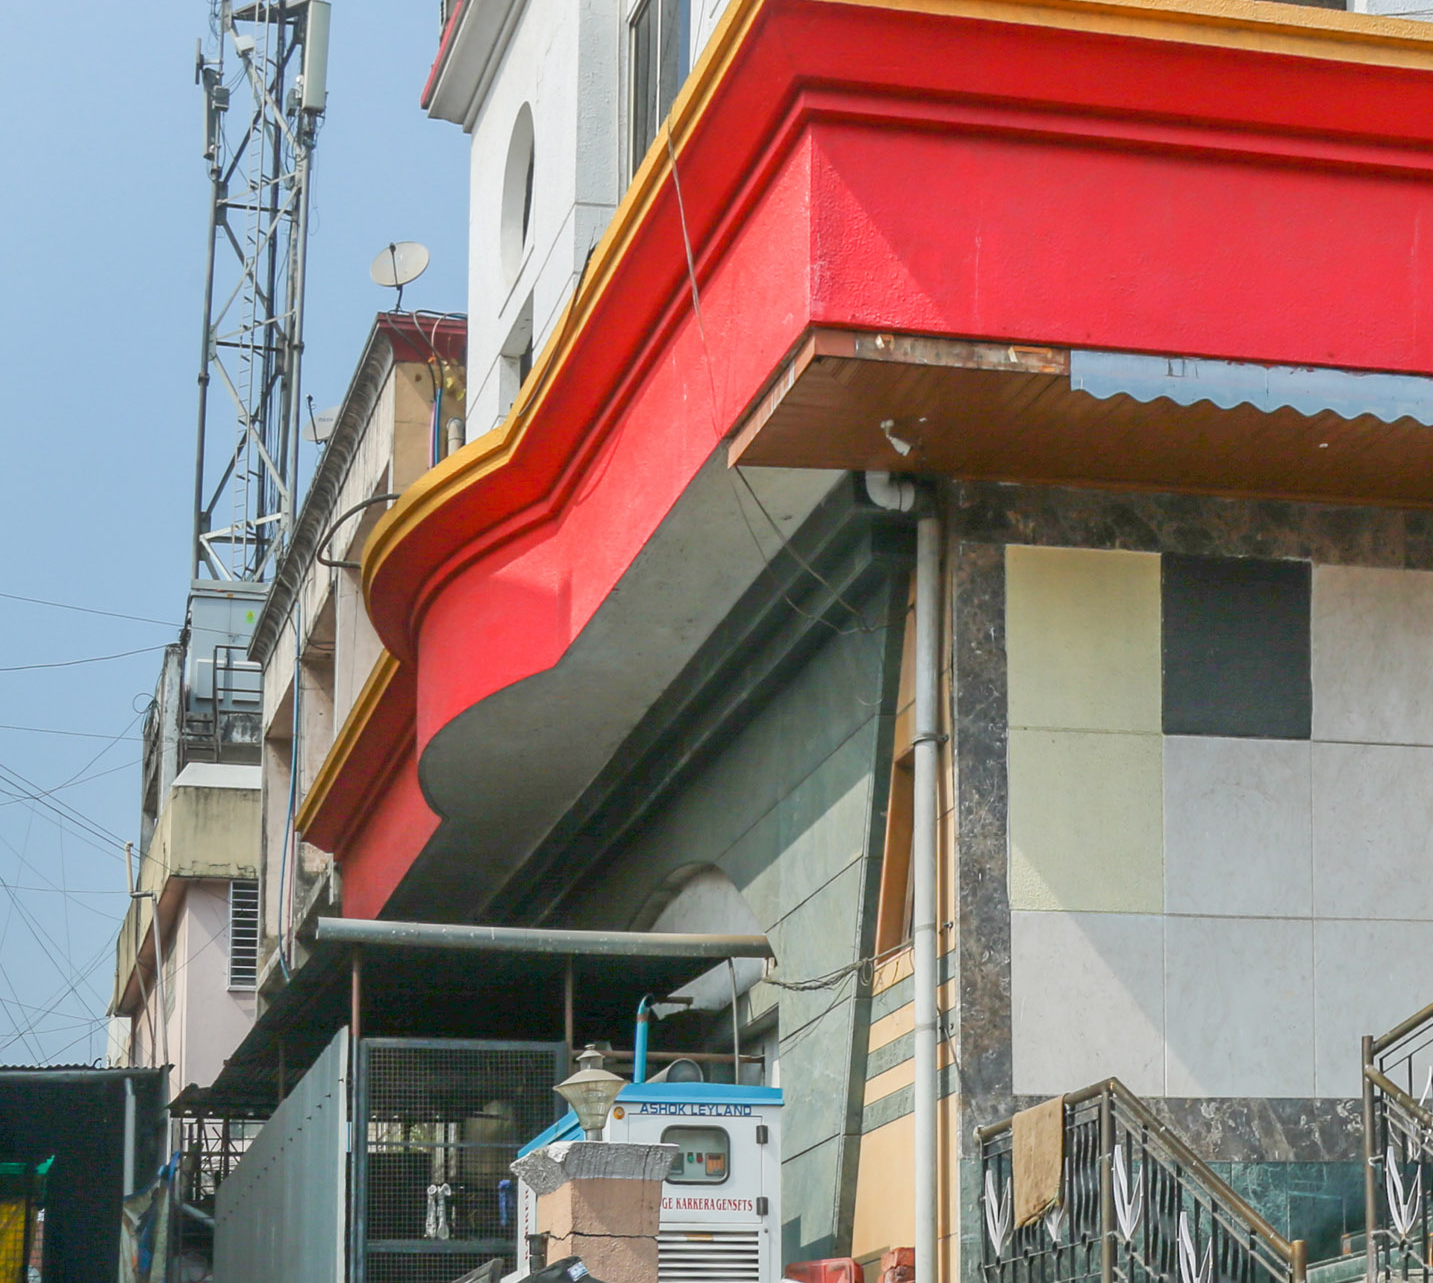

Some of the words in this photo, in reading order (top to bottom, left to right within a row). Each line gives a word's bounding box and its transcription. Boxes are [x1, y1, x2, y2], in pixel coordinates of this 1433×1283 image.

[640, 1103, 686, 1115] ASHOK
[690, 1104, 752, 1116] LEYLAND
[676, 1198, 715, 1210] KARKERA
[716, 1198, 753, 1211] GENSETS
